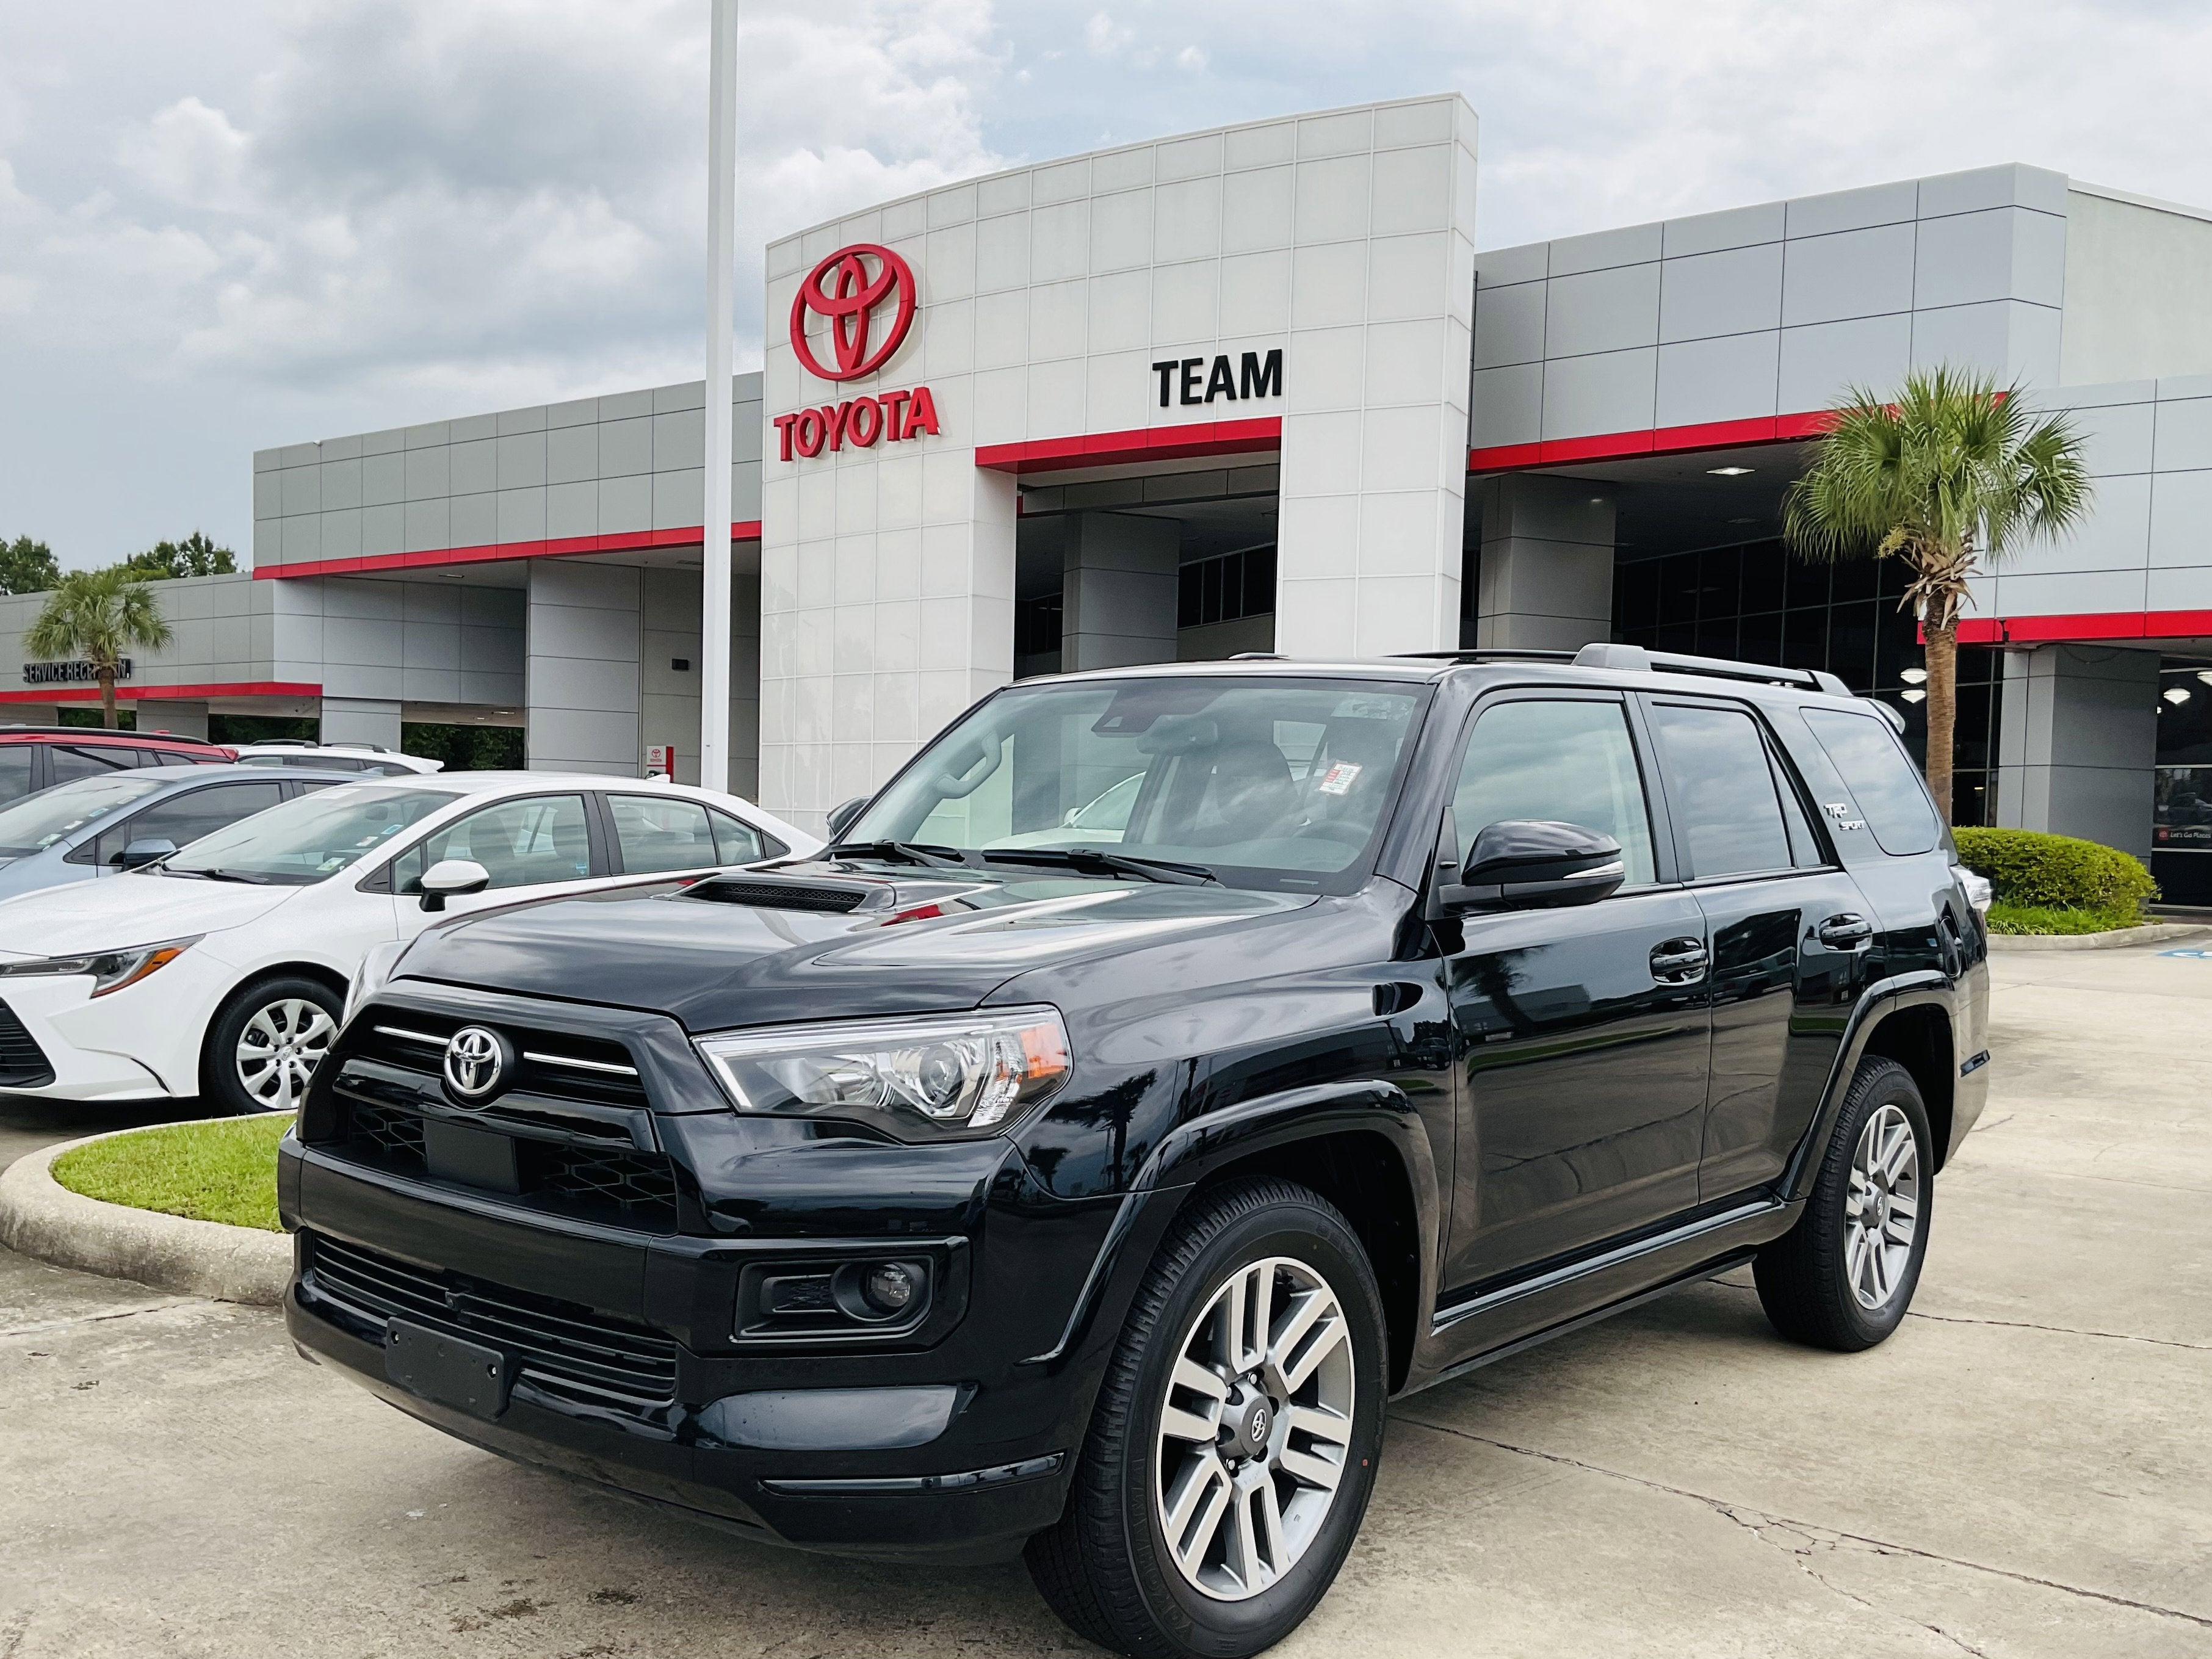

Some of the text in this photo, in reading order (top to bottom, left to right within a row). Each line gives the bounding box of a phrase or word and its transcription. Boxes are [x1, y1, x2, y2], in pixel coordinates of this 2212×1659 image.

[1152, 349, 1283, 407] TEAM
[773, 386, 941, 462] TOYOTA
[23, 663, 65, 683] SERVICE
[1824, 803, 1848, 819] TRD
[1839, 820, 1866, 831] SPORT
